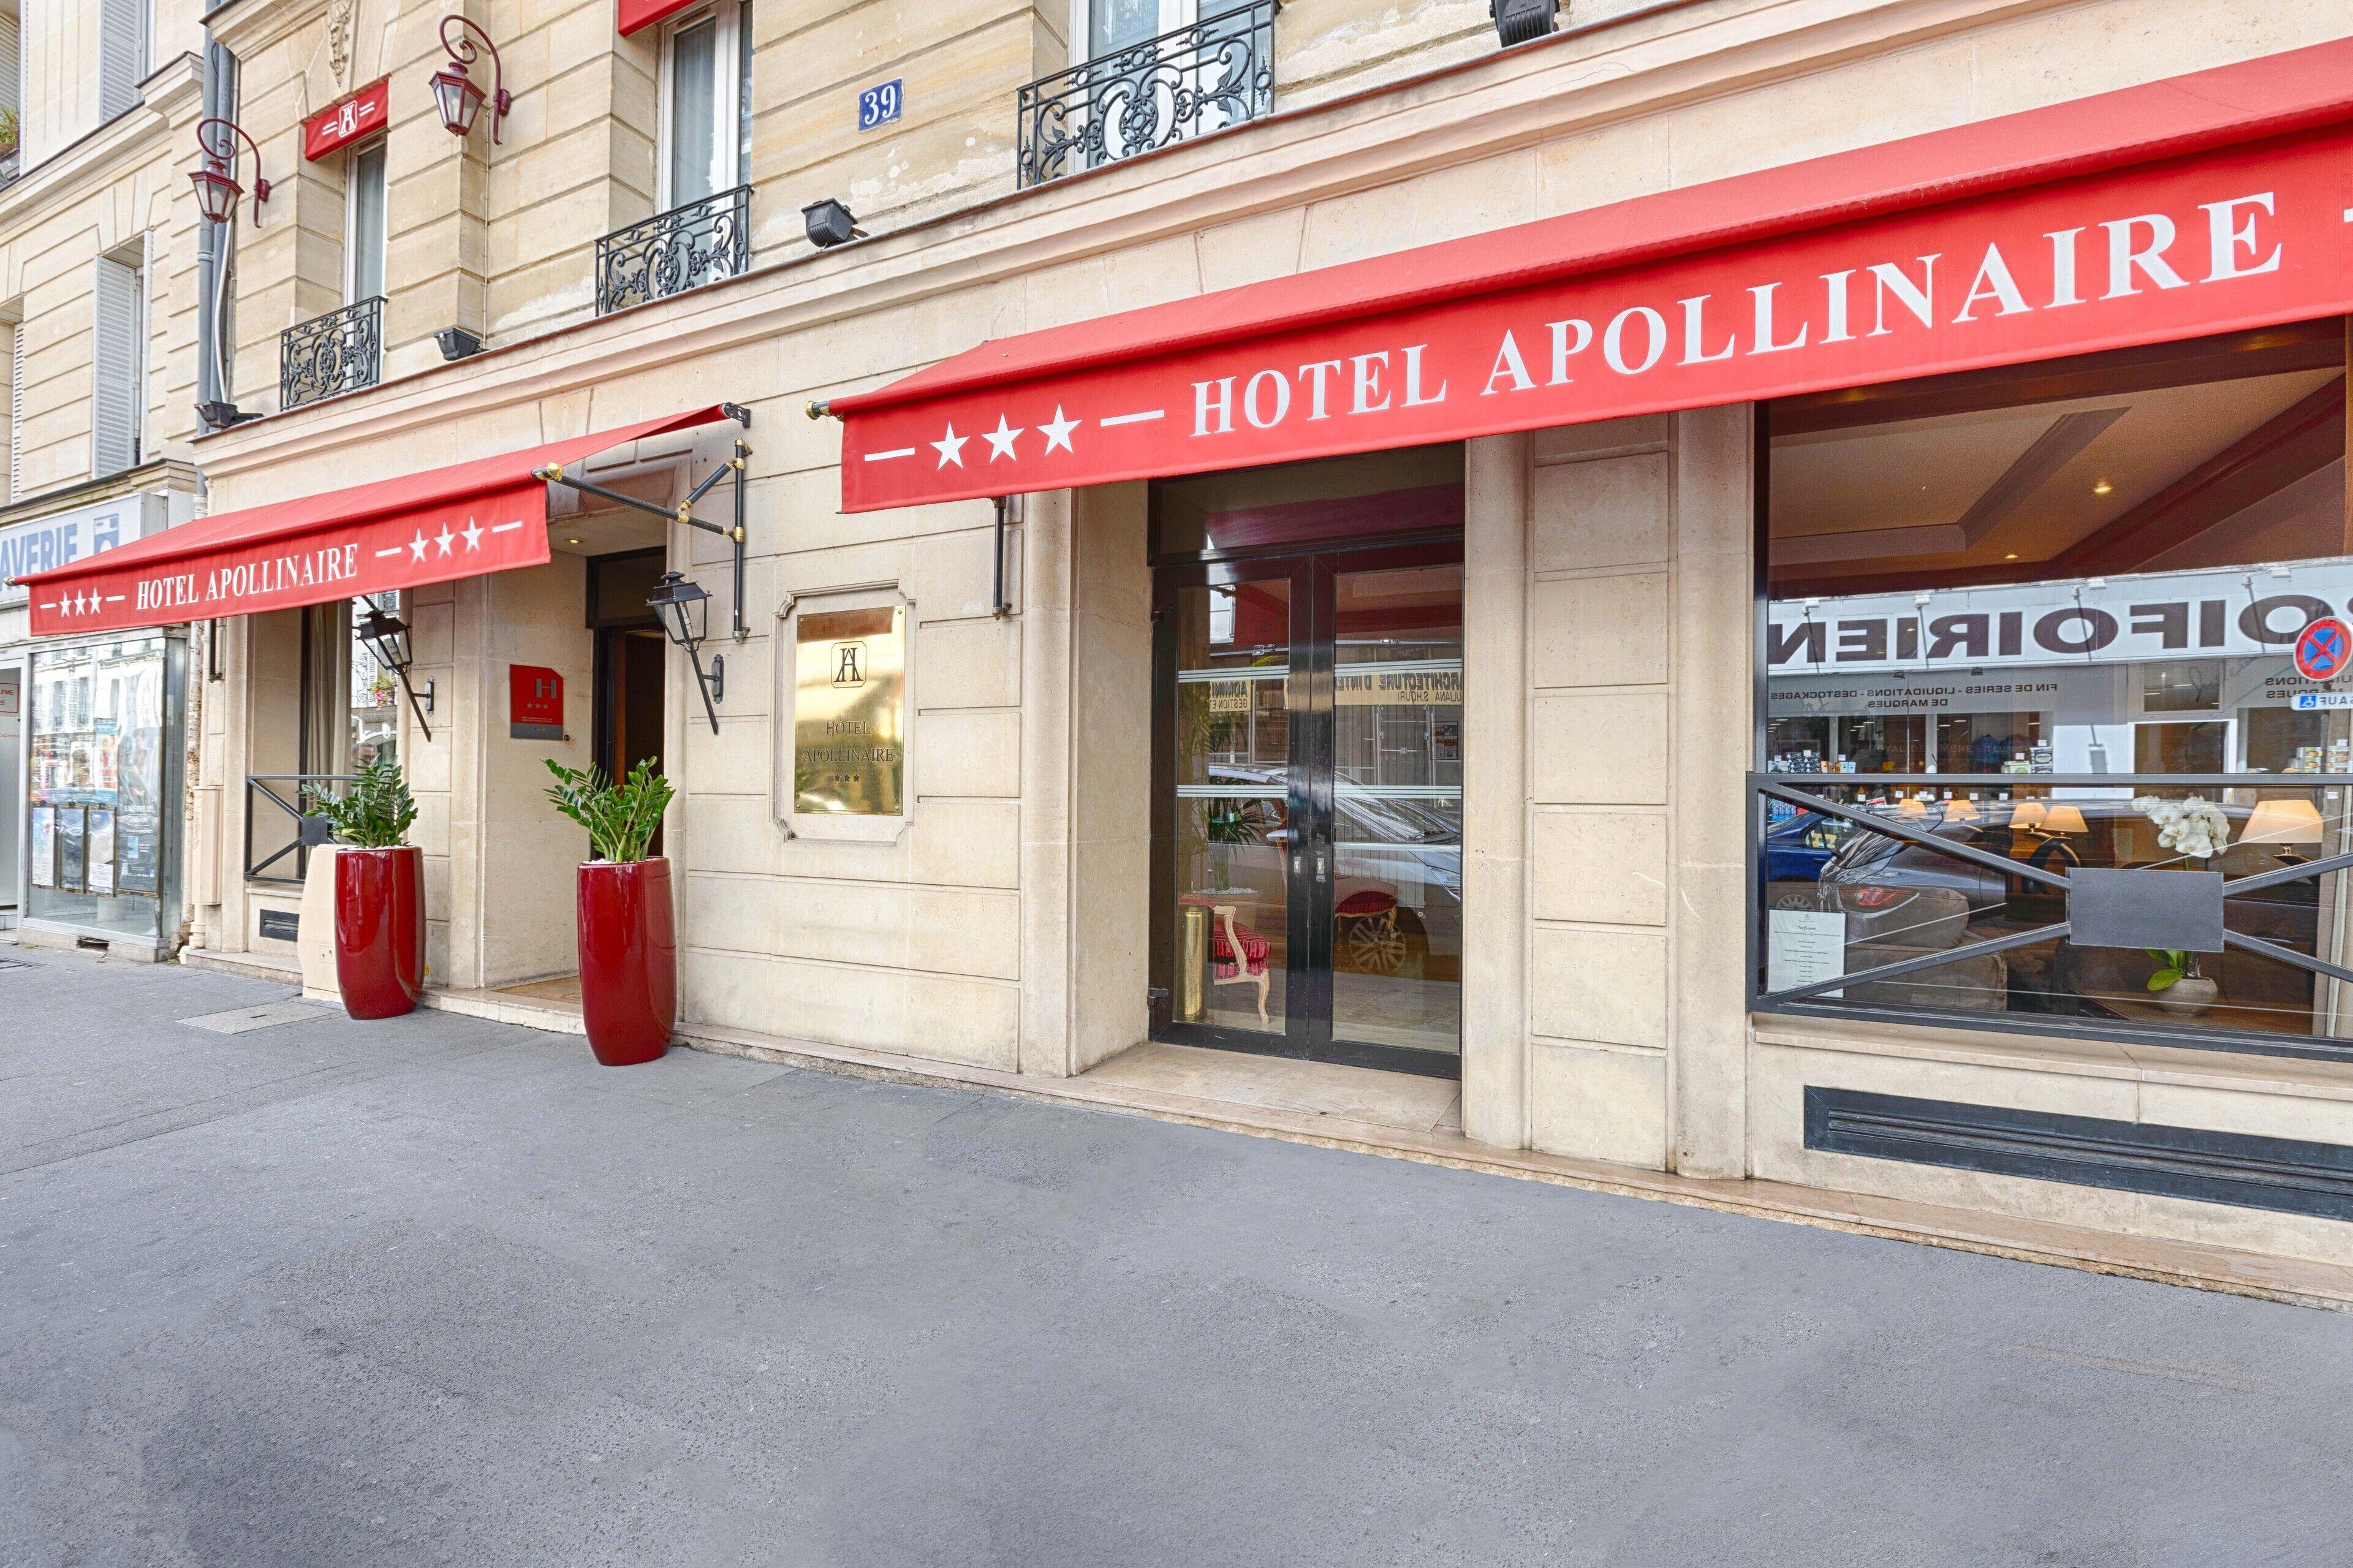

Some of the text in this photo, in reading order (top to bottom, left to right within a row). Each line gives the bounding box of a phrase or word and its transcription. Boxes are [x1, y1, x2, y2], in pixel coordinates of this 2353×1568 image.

[864, 85, 896, 126] 39
[1190, 191, 2283, 438] HOTEL APOLLINAIRE
[136, 543, 358, 610] HOTEL APOLLINAIRE
[535, 678, 557, 699] H
[826, 720, 871, 736] HOTEL
[803, 748, 895, 762] APOLLINAIRE
